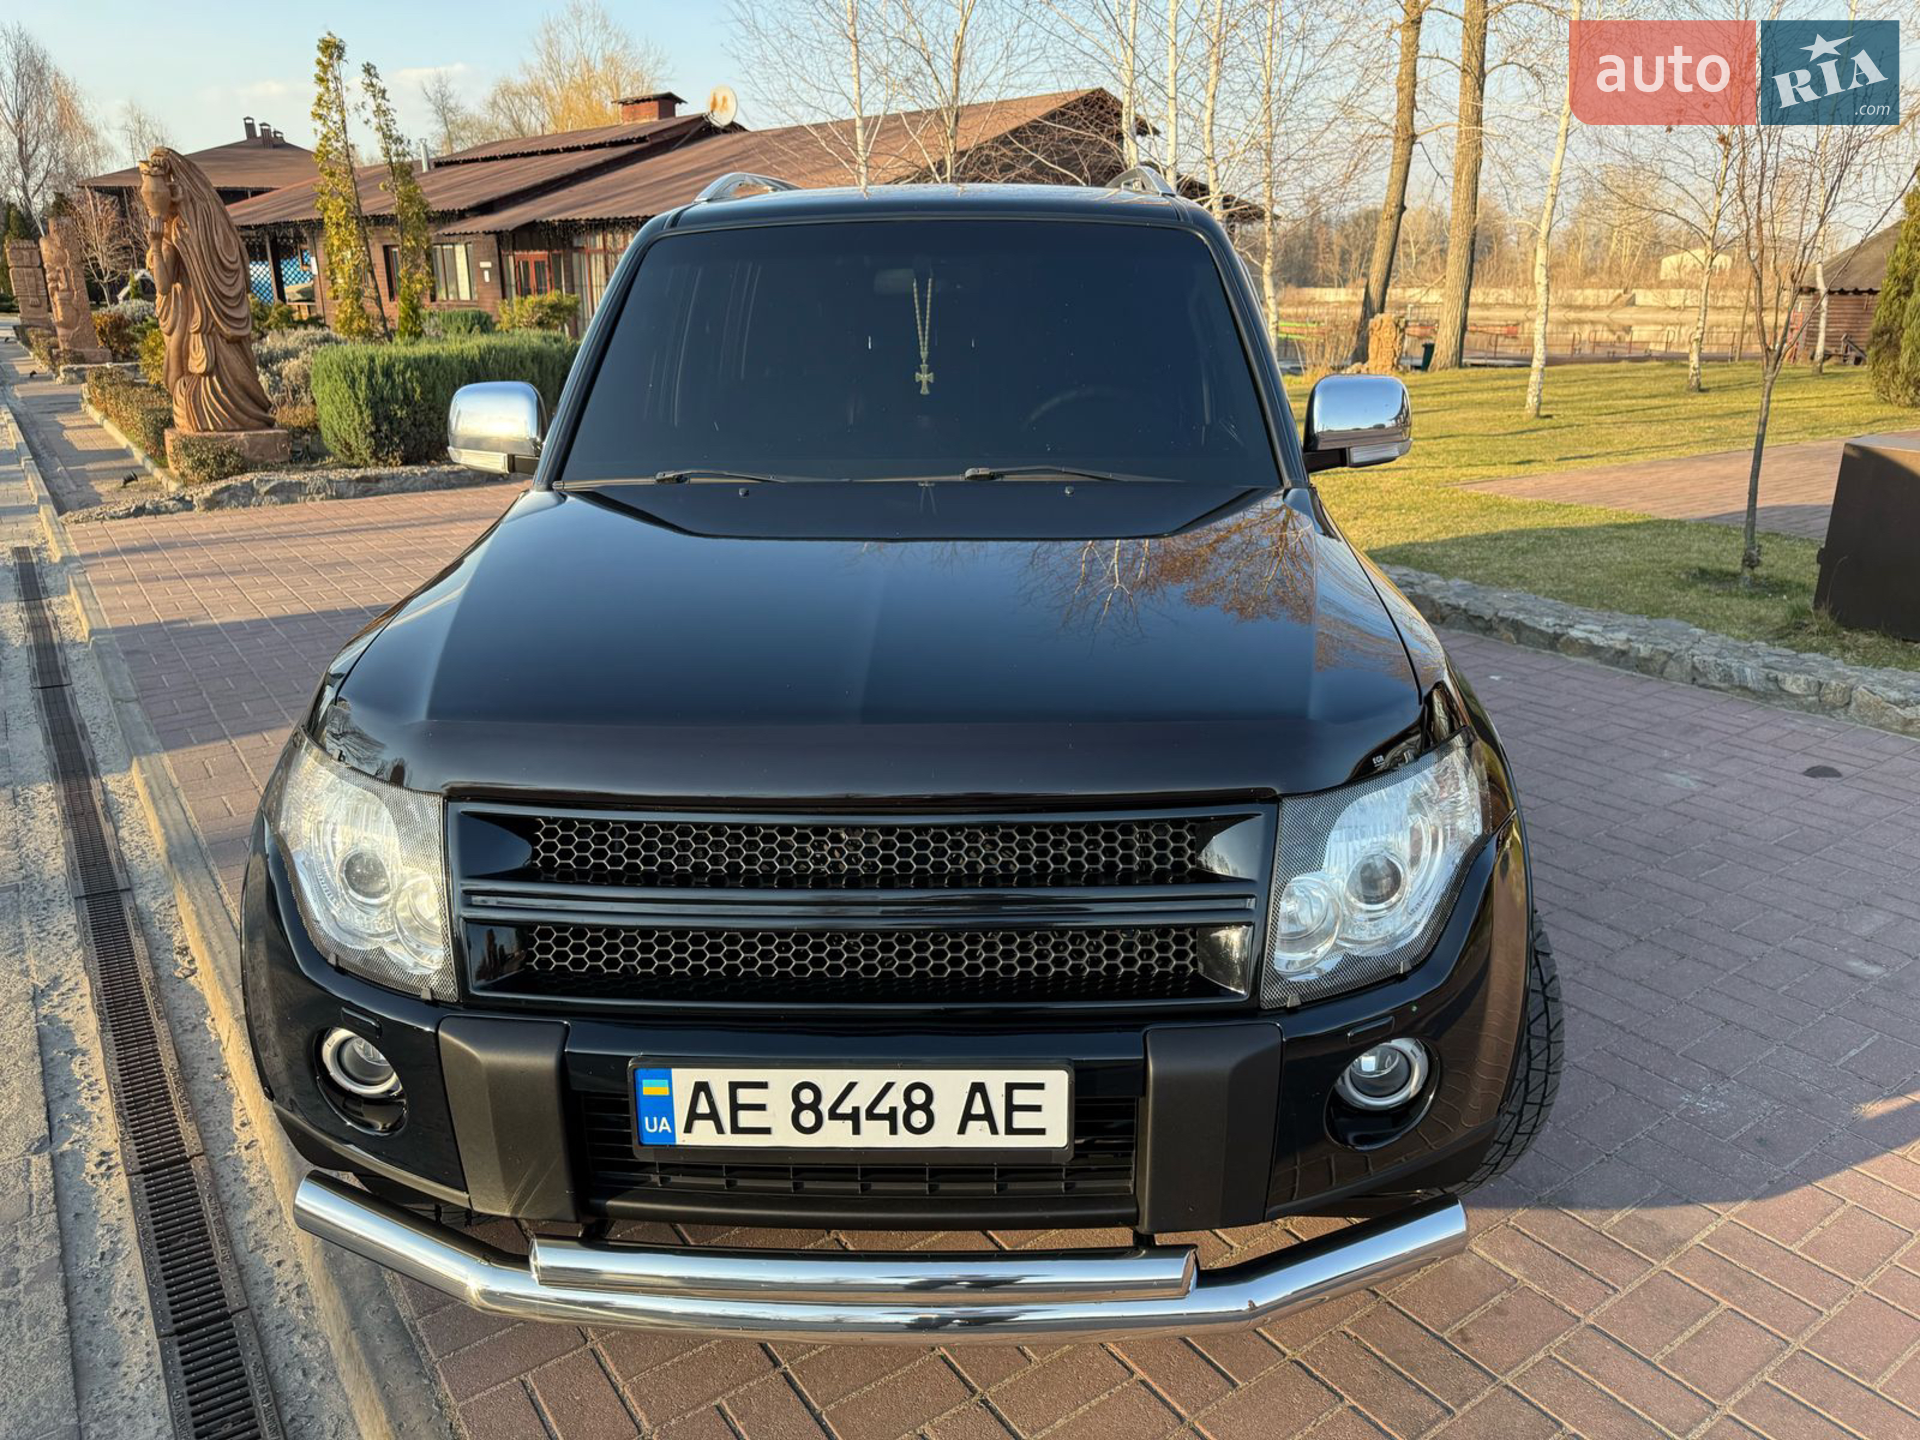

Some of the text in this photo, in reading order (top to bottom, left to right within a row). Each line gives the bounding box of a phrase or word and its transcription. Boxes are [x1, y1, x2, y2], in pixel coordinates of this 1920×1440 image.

[644, 1116, 672, 1134] UA
[683, 1081, 1047, 1136] AE 8448 AE
